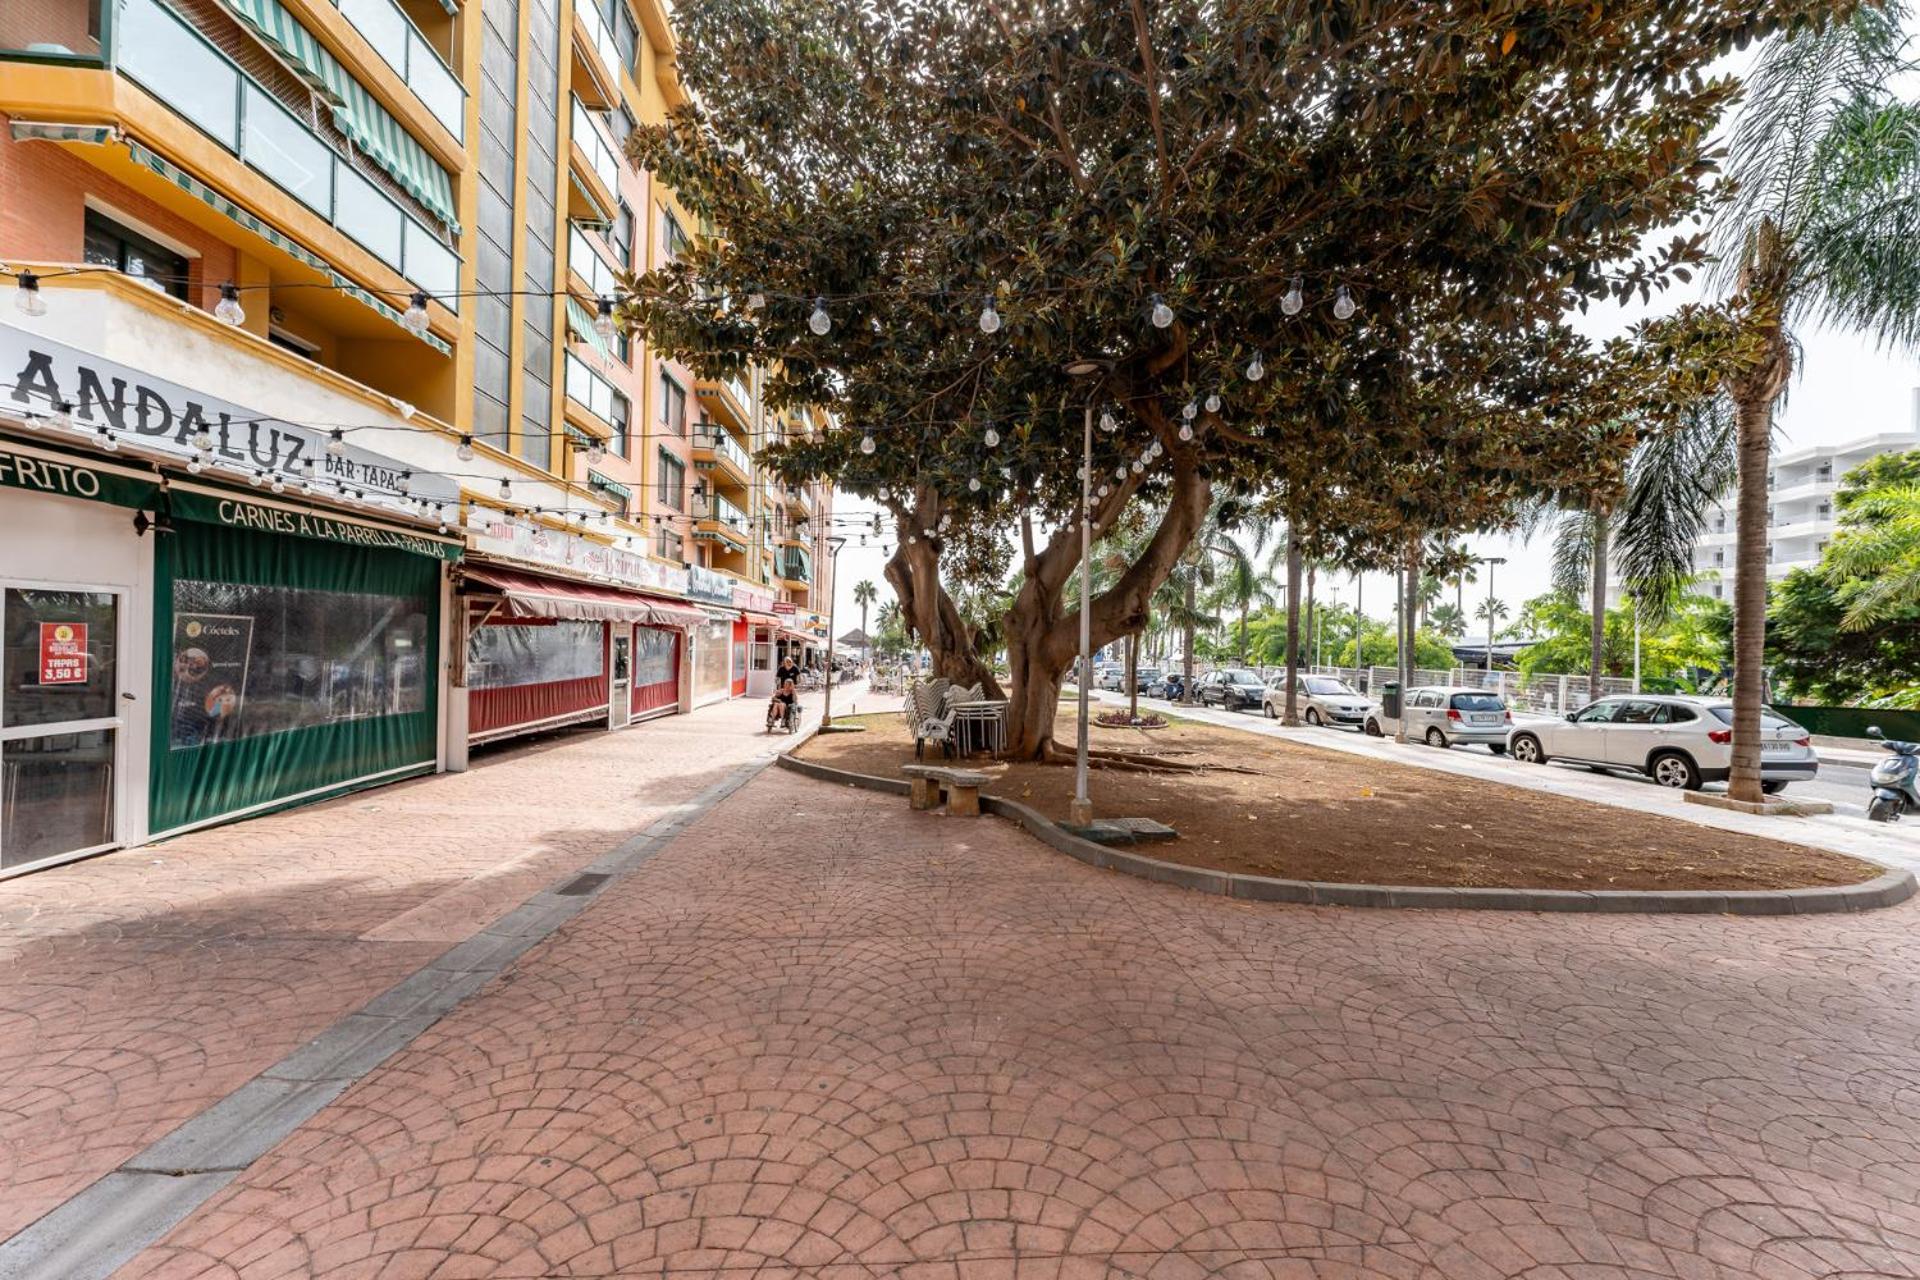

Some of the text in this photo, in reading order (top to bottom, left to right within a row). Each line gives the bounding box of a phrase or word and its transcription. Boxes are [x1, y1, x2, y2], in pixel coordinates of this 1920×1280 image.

[11, 349, 305, 475] ANDALUZ
[0, 453, 99, 497] FRITO
[219, 500, 295, 532] CARNES
[300, 515, 312, 535] A
[314, 518, 337, 539] LA
[45, 669, 71, 680] 3,50
[48, 659, 79, 668] TAPAS
